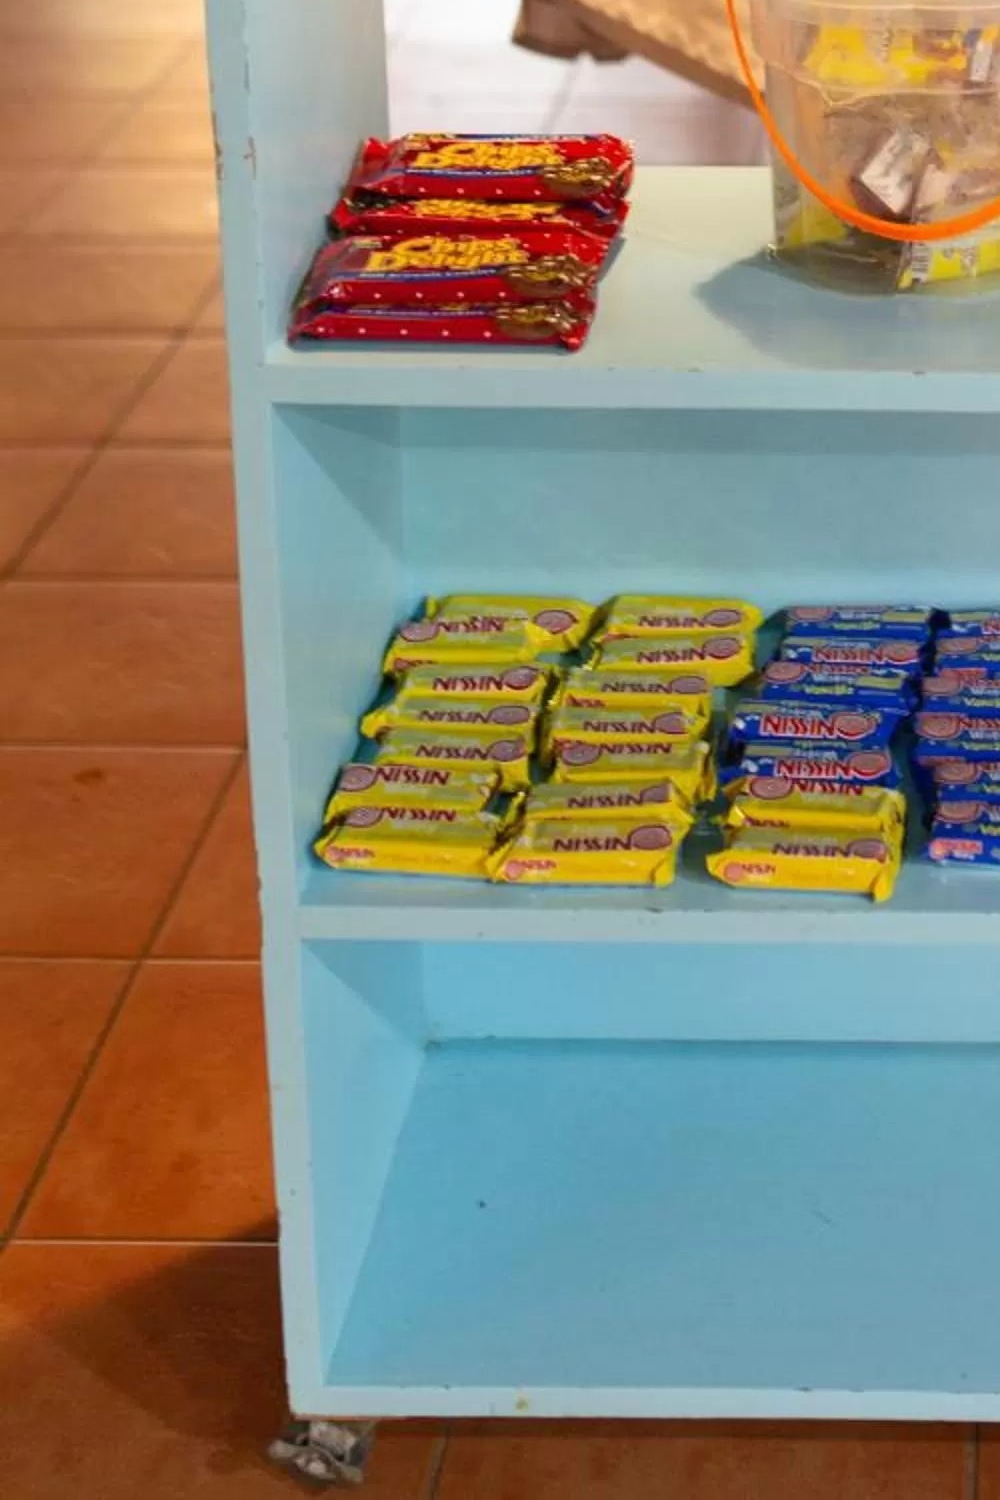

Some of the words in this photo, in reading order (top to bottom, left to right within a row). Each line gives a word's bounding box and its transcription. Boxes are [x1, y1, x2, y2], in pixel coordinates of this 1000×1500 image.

[393, 236, 521, 253] Chips
[638, 615, 705, 628] NISSIN
[636, 647, 706, 663] NISSIN
[433, 675, 504, 691] NISSIN
[418, 709, 491, 724] NISSIN
[763, 714, 835, 735] NISSIN
[583, 720, 656, 733] NISSIN
[416, 744, 490, 760] NISSIN
[374, 767, 450, 785] NISSIN
[777, 760, 852, 777] NISSIN
[792, 779, 864, 795] NISSIN
[567, 794, 643, 808] NISSIN
[381, 807, 456, 821] NISSIN
[554, 835, 632, 851] NISSIN
[772, 843, 850, 857] NISSIN
